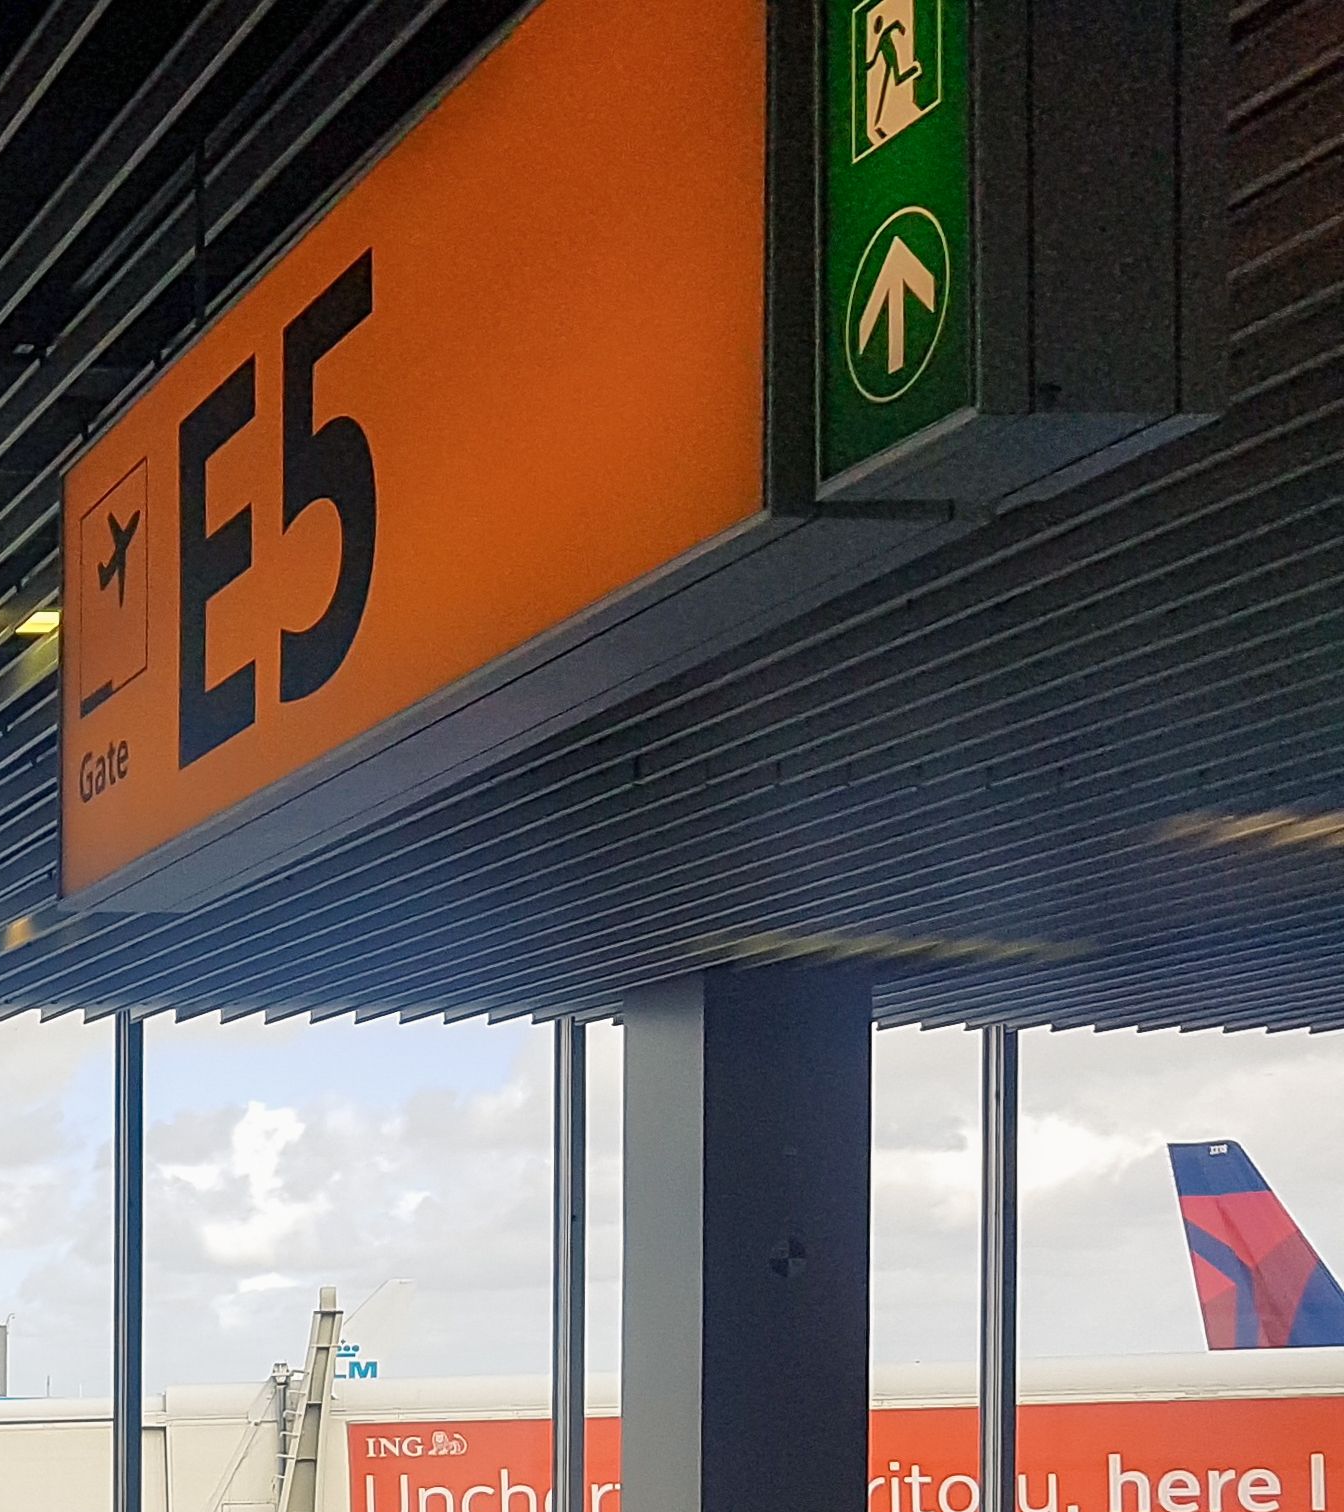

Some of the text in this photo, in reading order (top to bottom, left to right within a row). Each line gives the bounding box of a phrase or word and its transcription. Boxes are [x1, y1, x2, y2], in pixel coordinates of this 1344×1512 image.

[179, 247, 377, 770] E5
[80, 740, 129, 803] Gate
[365, 1437, 424, 1458] ING
[1310, 1453, 1326, 1512] I
